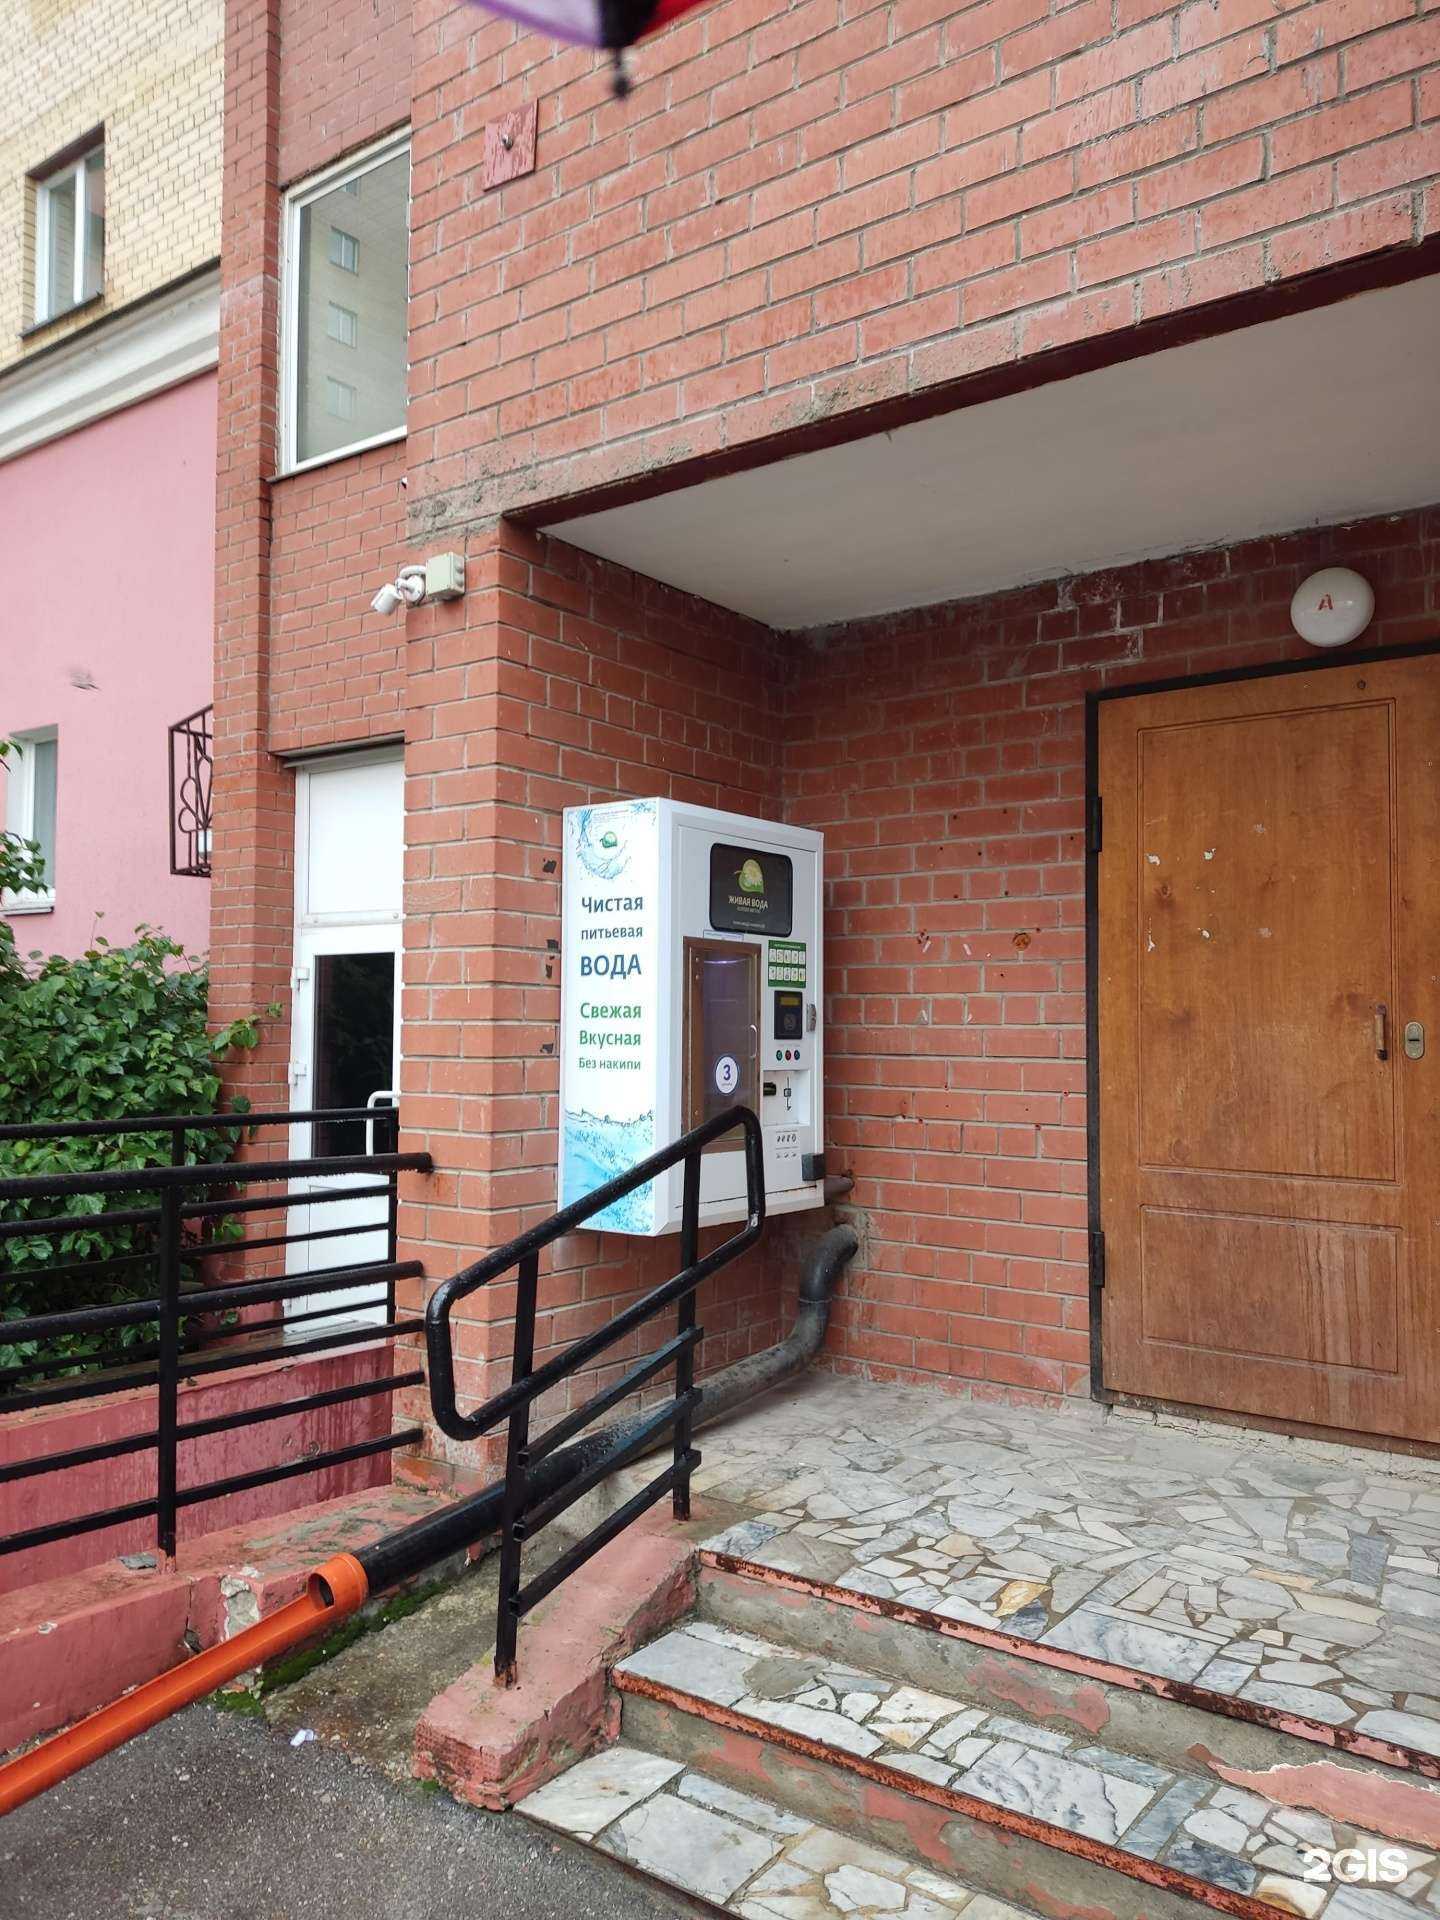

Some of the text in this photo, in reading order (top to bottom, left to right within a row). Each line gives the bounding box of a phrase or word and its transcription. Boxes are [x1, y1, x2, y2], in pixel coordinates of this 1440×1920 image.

[581, 896, 643, 914] Чистая
[728, 895, 768, 909] ЖИВАЯ ВОДА
[581, 926, 643, 940] питьевая
[580, 953, 642, 980] ВОДА
[580, 1002, 642, 1019] Свежая
[579, 1030, 641, 1050] Вкусная
[579, 1058, 641, 1071] Без накипи
[723, 1064, 731, 1081] 3
